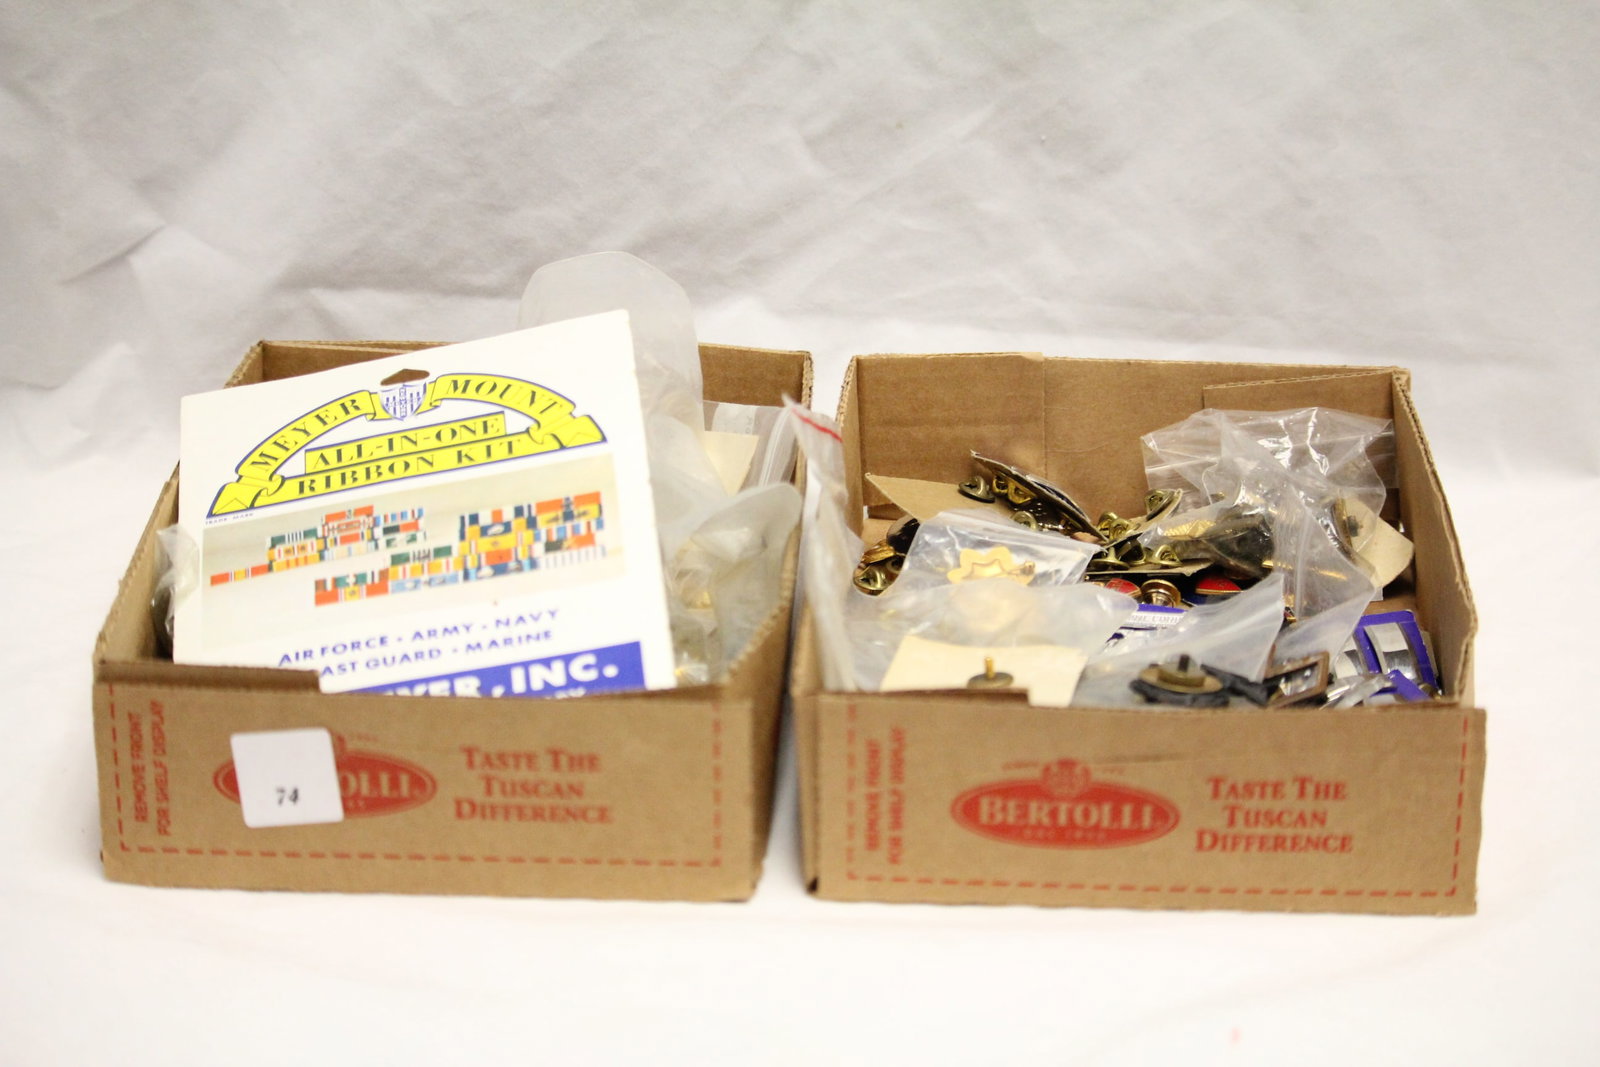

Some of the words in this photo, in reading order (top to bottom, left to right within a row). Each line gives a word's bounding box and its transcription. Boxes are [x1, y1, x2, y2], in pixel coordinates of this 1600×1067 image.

[249, 397, 363, 473] MEYER
[444, 377, 565, 416] MOUNT
[312, 416, 502, 469] ALL-IN-ONE
[298, 453, 436, 495] RIBBON
[456, 438, 525, 466] KIT
[278, 649, 313, 667] AIR
[320, 636, 388, 656] FORCE
[412, 623, 473, 642] ARMY
[495, 609, 559, 628] NAVY
[320, 660, 358, 678] AST
[365, 648, 441, 671] GUARD
[466, 630, 552, 653] MARINE
[511, 652, 619, 694] INC.
[275, 786, 299, 806] 74
[340, 770, 410, 799] OLLI
[156, 808, 171, 836] FOR
[979, 795, 1159, 831] BERTOLLI
